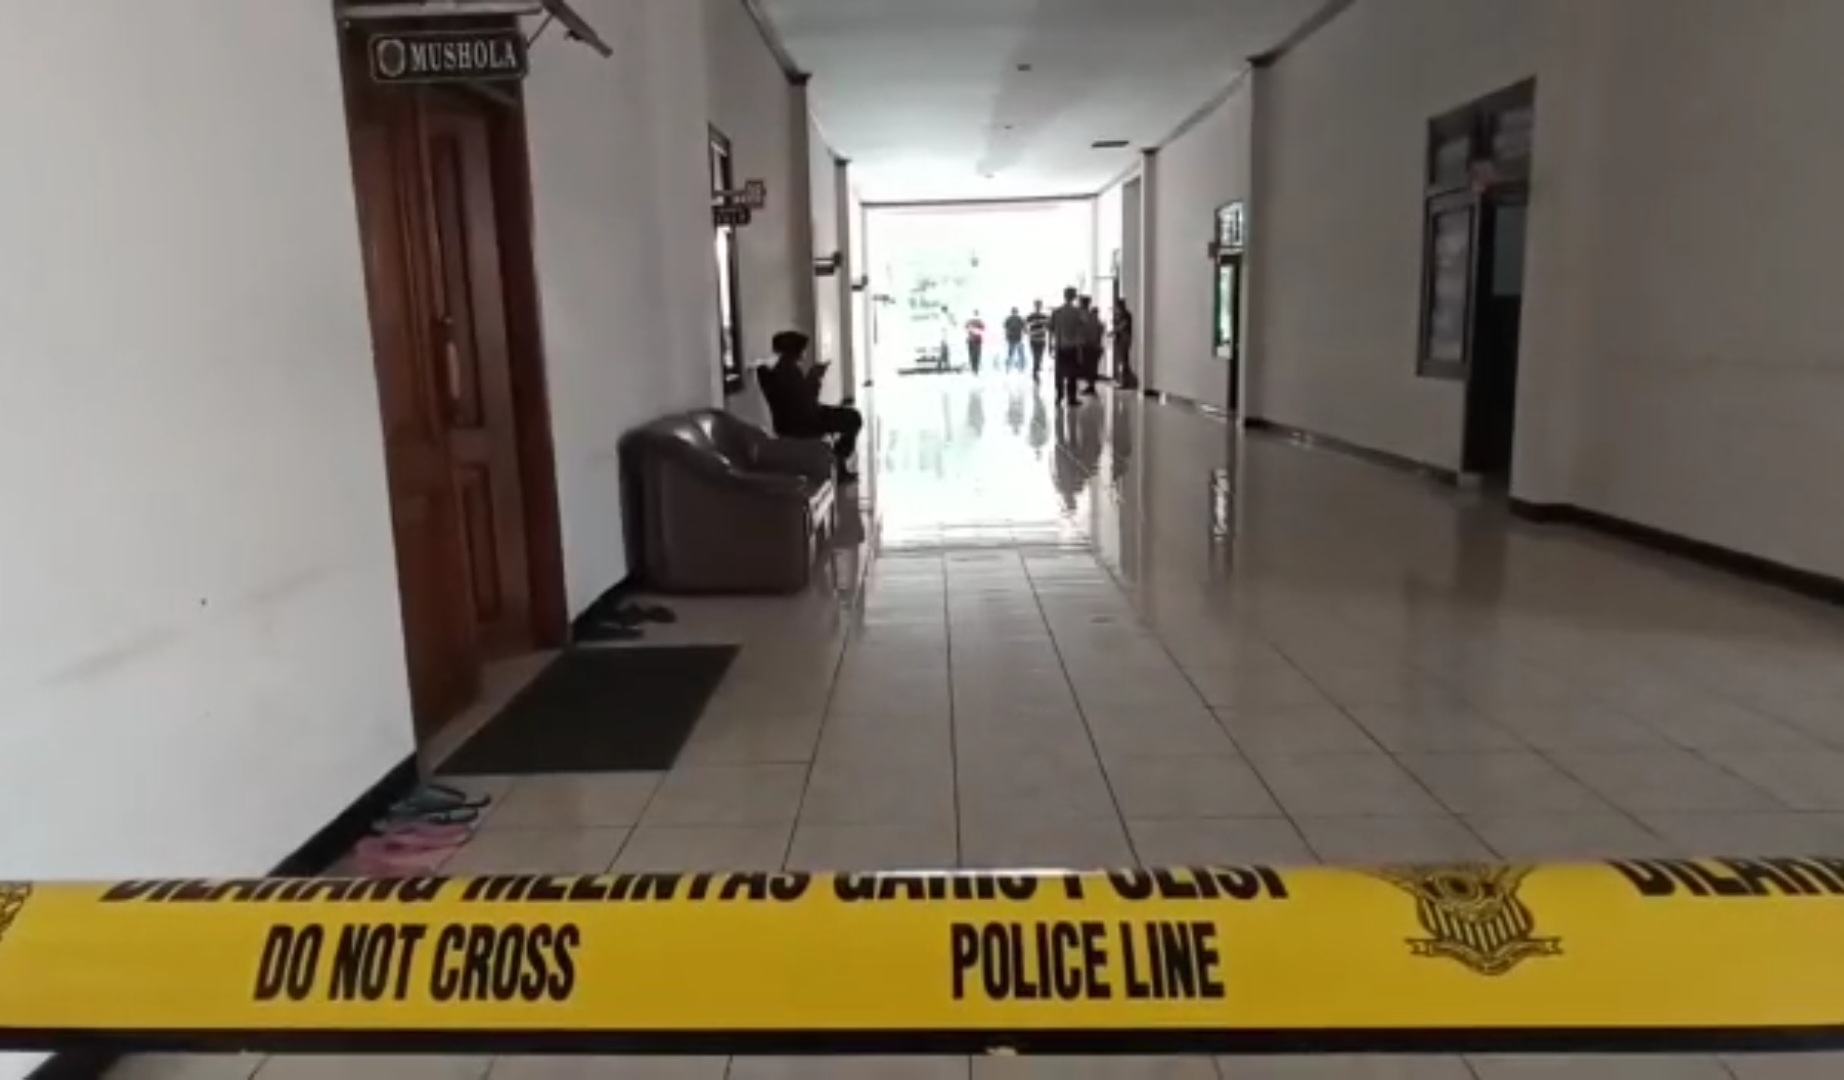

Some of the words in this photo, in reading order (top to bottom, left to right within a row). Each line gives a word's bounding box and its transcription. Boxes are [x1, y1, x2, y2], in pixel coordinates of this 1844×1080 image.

[410, 40, 517, 72] MUSHOLA
[253, 923, 325, 1001] DO
[329, 923, 429, 1001] NOT
[429, 922, 581, 1001] CROSS
[951, 922, 1113, 1000] POLICE
[1118, 922, 1225, 999] LINE
